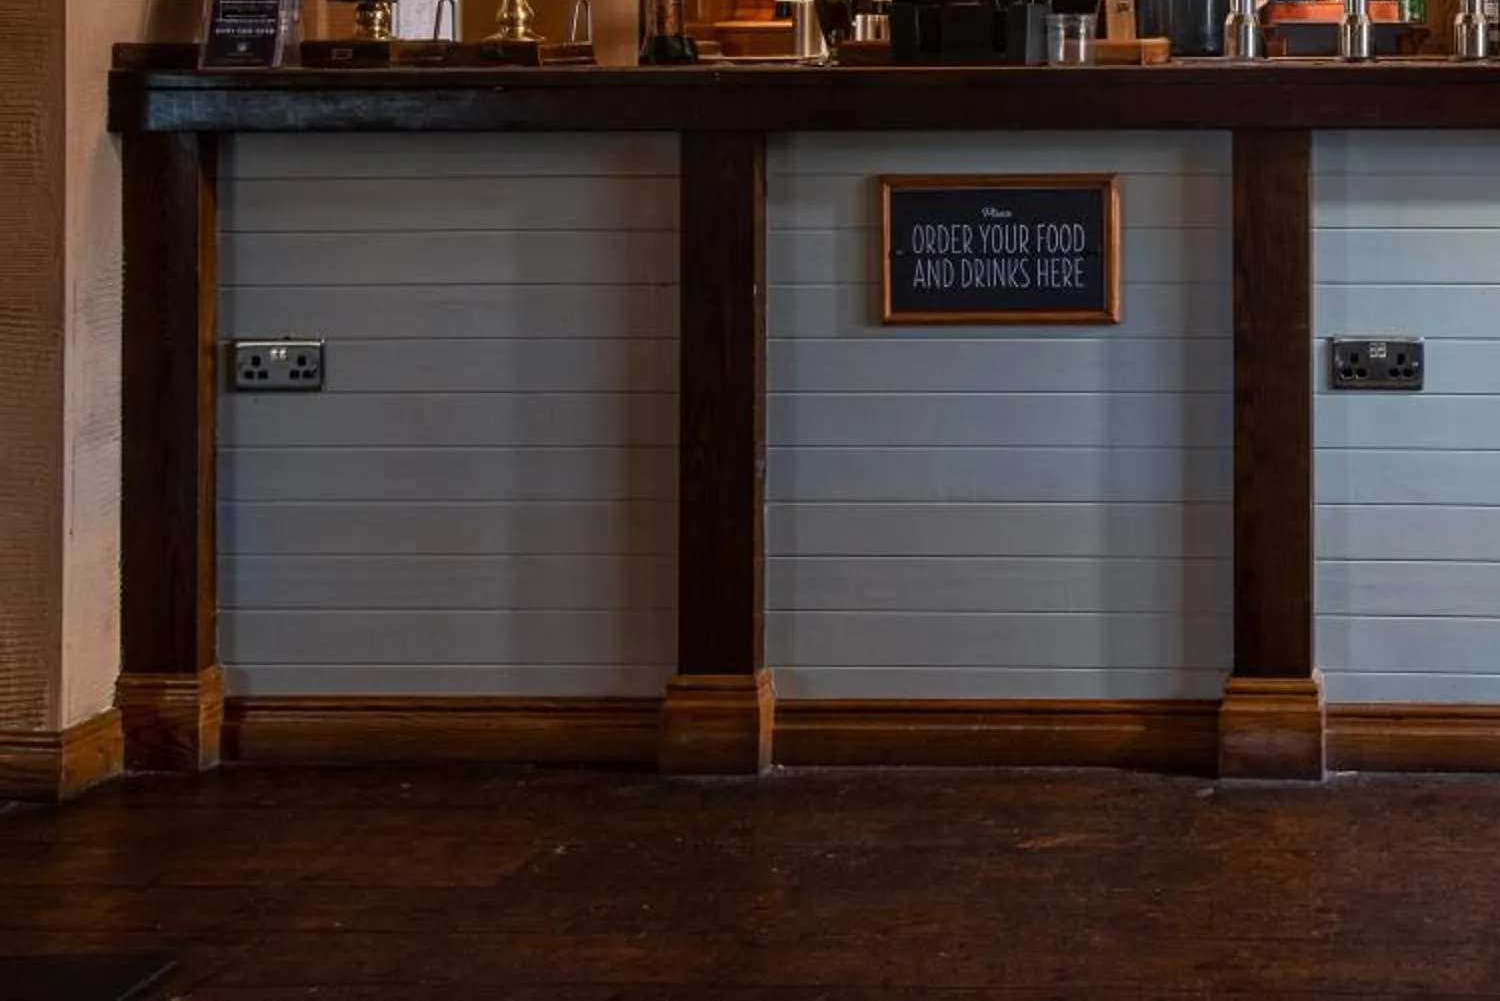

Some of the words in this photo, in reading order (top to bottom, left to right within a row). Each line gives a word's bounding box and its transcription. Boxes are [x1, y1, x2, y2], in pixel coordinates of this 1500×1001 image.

[911, 223, 974, 255] ORDER
[978, 223, 1030, 255] YOUR
[1036, 223, 1086, 253] FOOD
[913, 257, 955, 289] AND
[960, 257, 1031, 289] DRINKS
[1036, 257, 1086, 289] HERE
